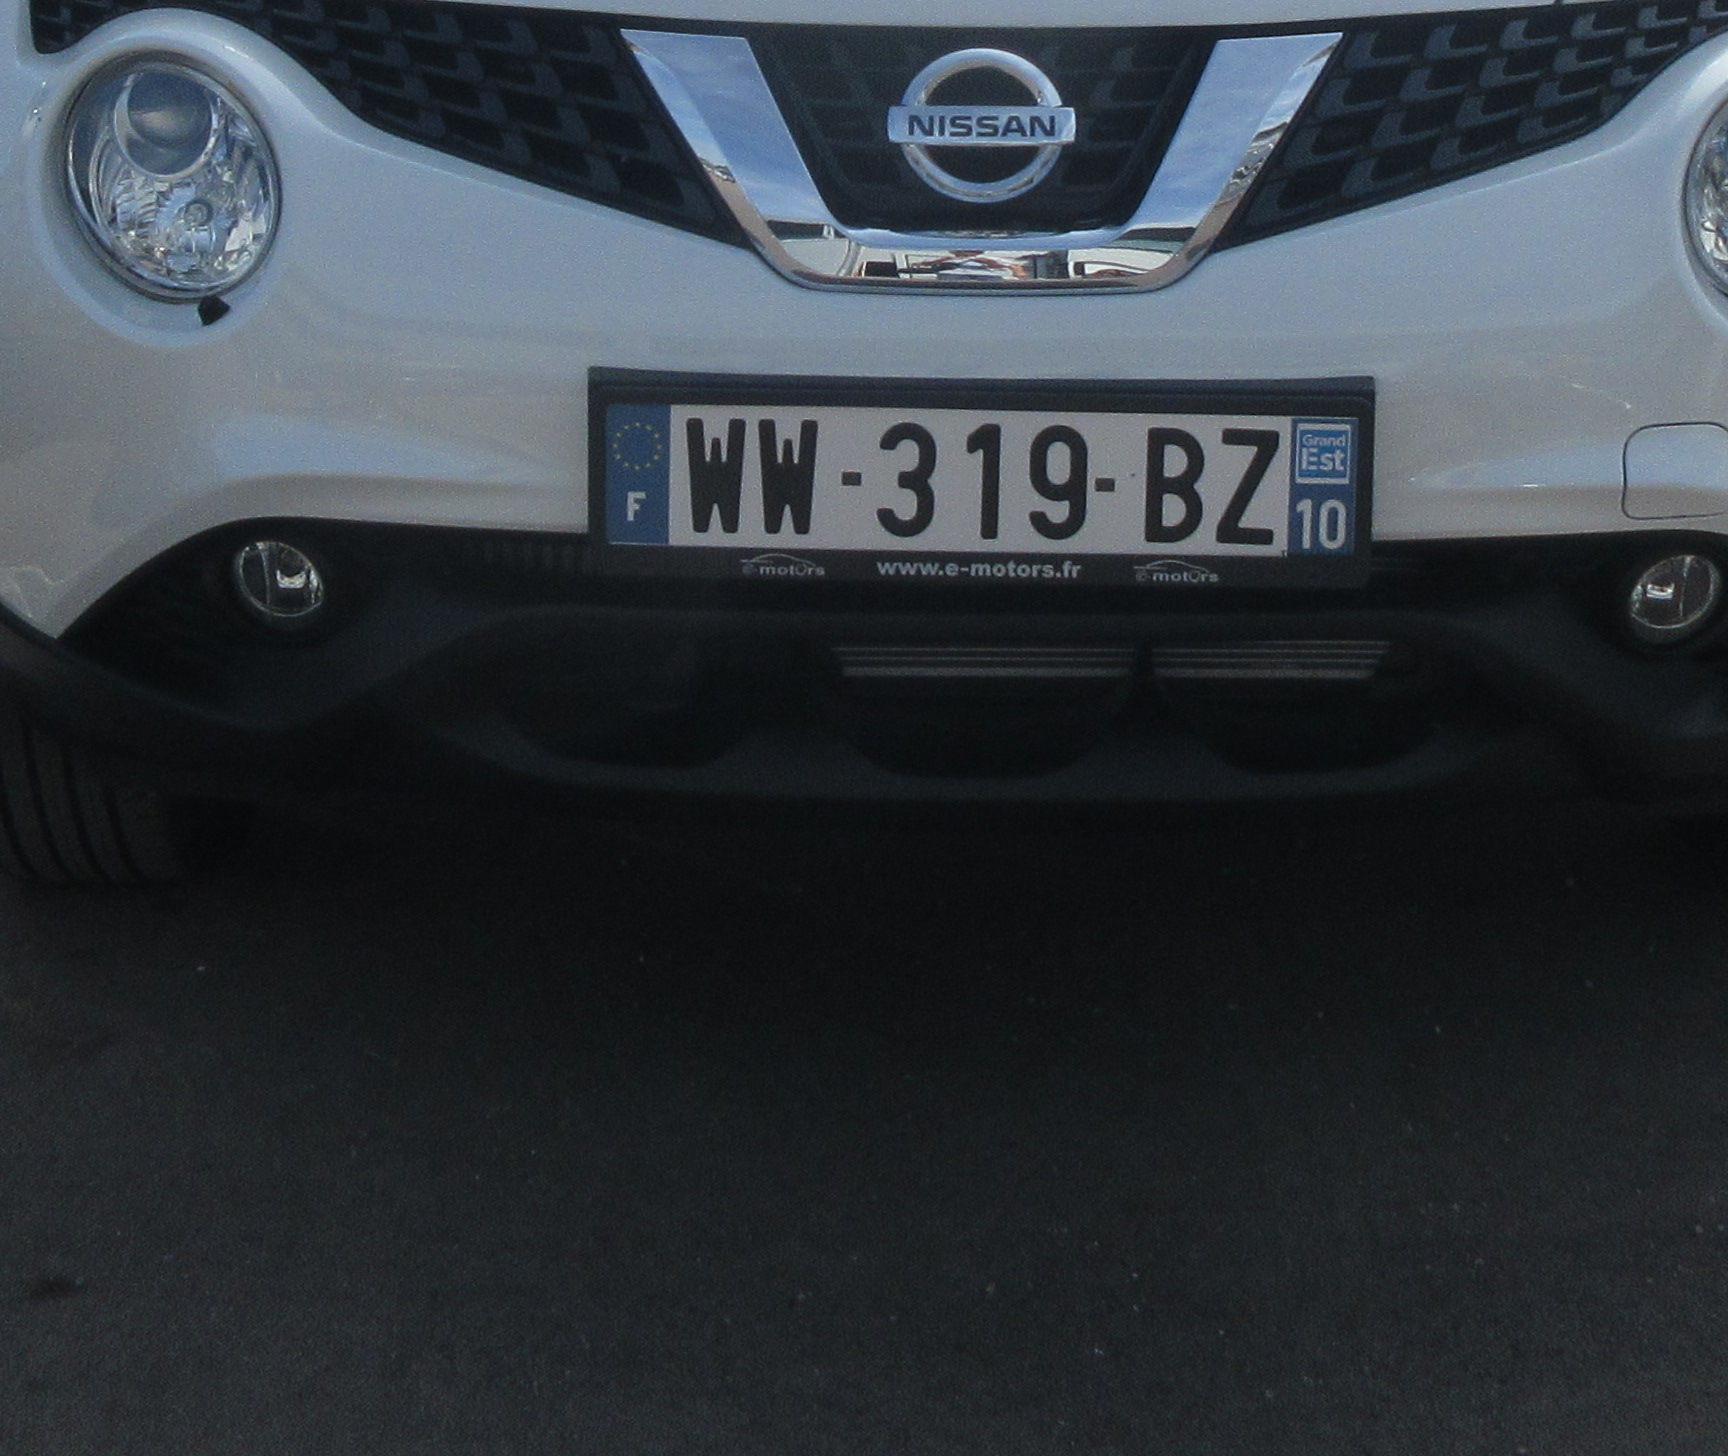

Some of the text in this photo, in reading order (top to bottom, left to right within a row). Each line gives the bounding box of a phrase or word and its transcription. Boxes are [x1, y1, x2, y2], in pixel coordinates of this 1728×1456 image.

[907, 114, 1057, 138] NISSAN
[1302, 433, 1347, 447] Grand
[1301, 446, 1346, 471] Est
[685, 417, 1280, 545] WW-319-BZ
[626, 491, 648, 523] F
[1295, 498, 1348, 550] 10
[877, 560, 1082, 579] www.e-motors.fr
